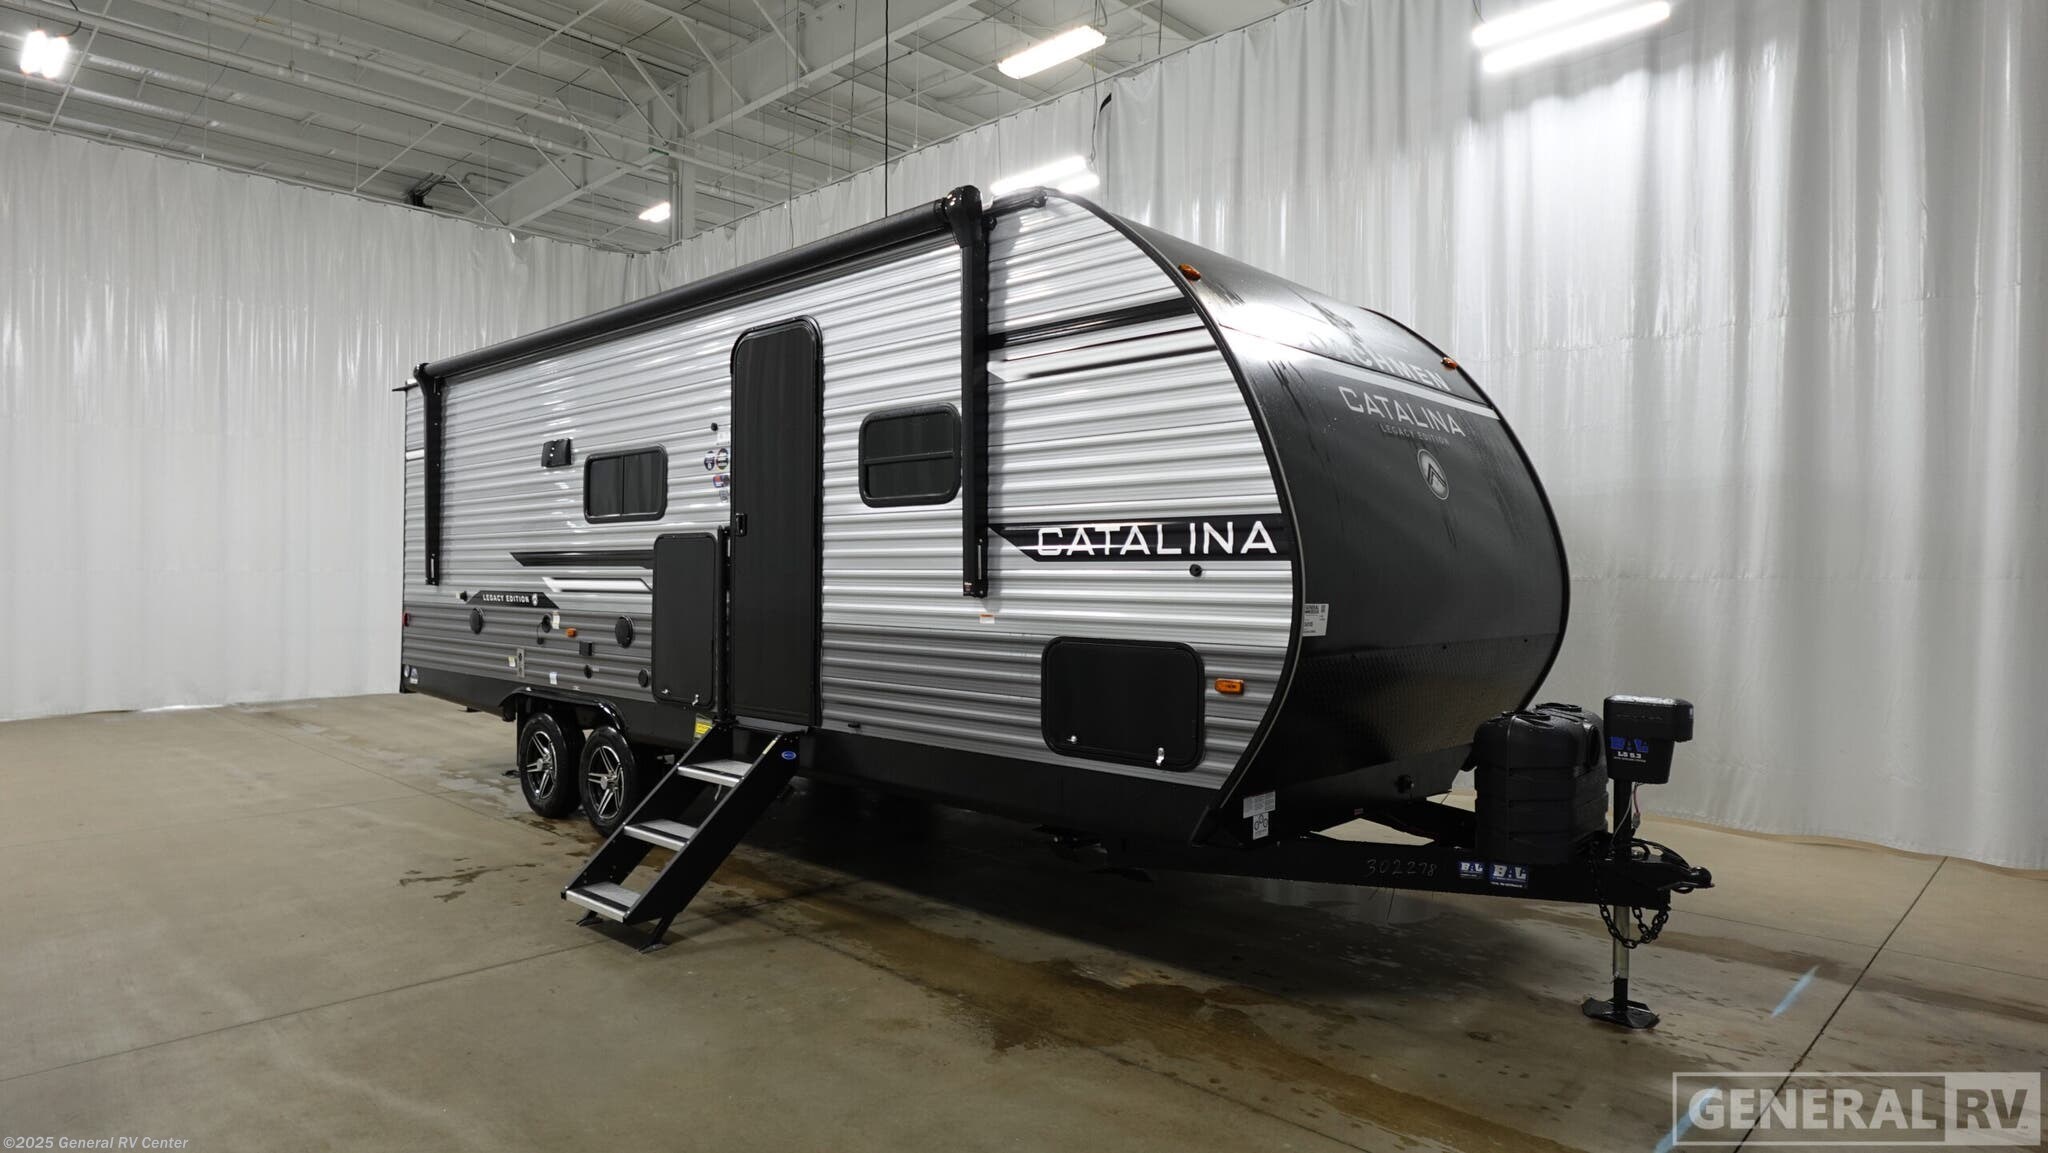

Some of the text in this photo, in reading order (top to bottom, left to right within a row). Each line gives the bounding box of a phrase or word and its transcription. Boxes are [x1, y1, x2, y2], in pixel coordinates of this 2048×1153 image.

[1338, 385, 1466, 437] CATALINA
[1037, 520, 1278, 556] CATALINA
[482, 593, 530, 603] LEGACY EDITION
[1366, 857, 1438, 878] 302278
